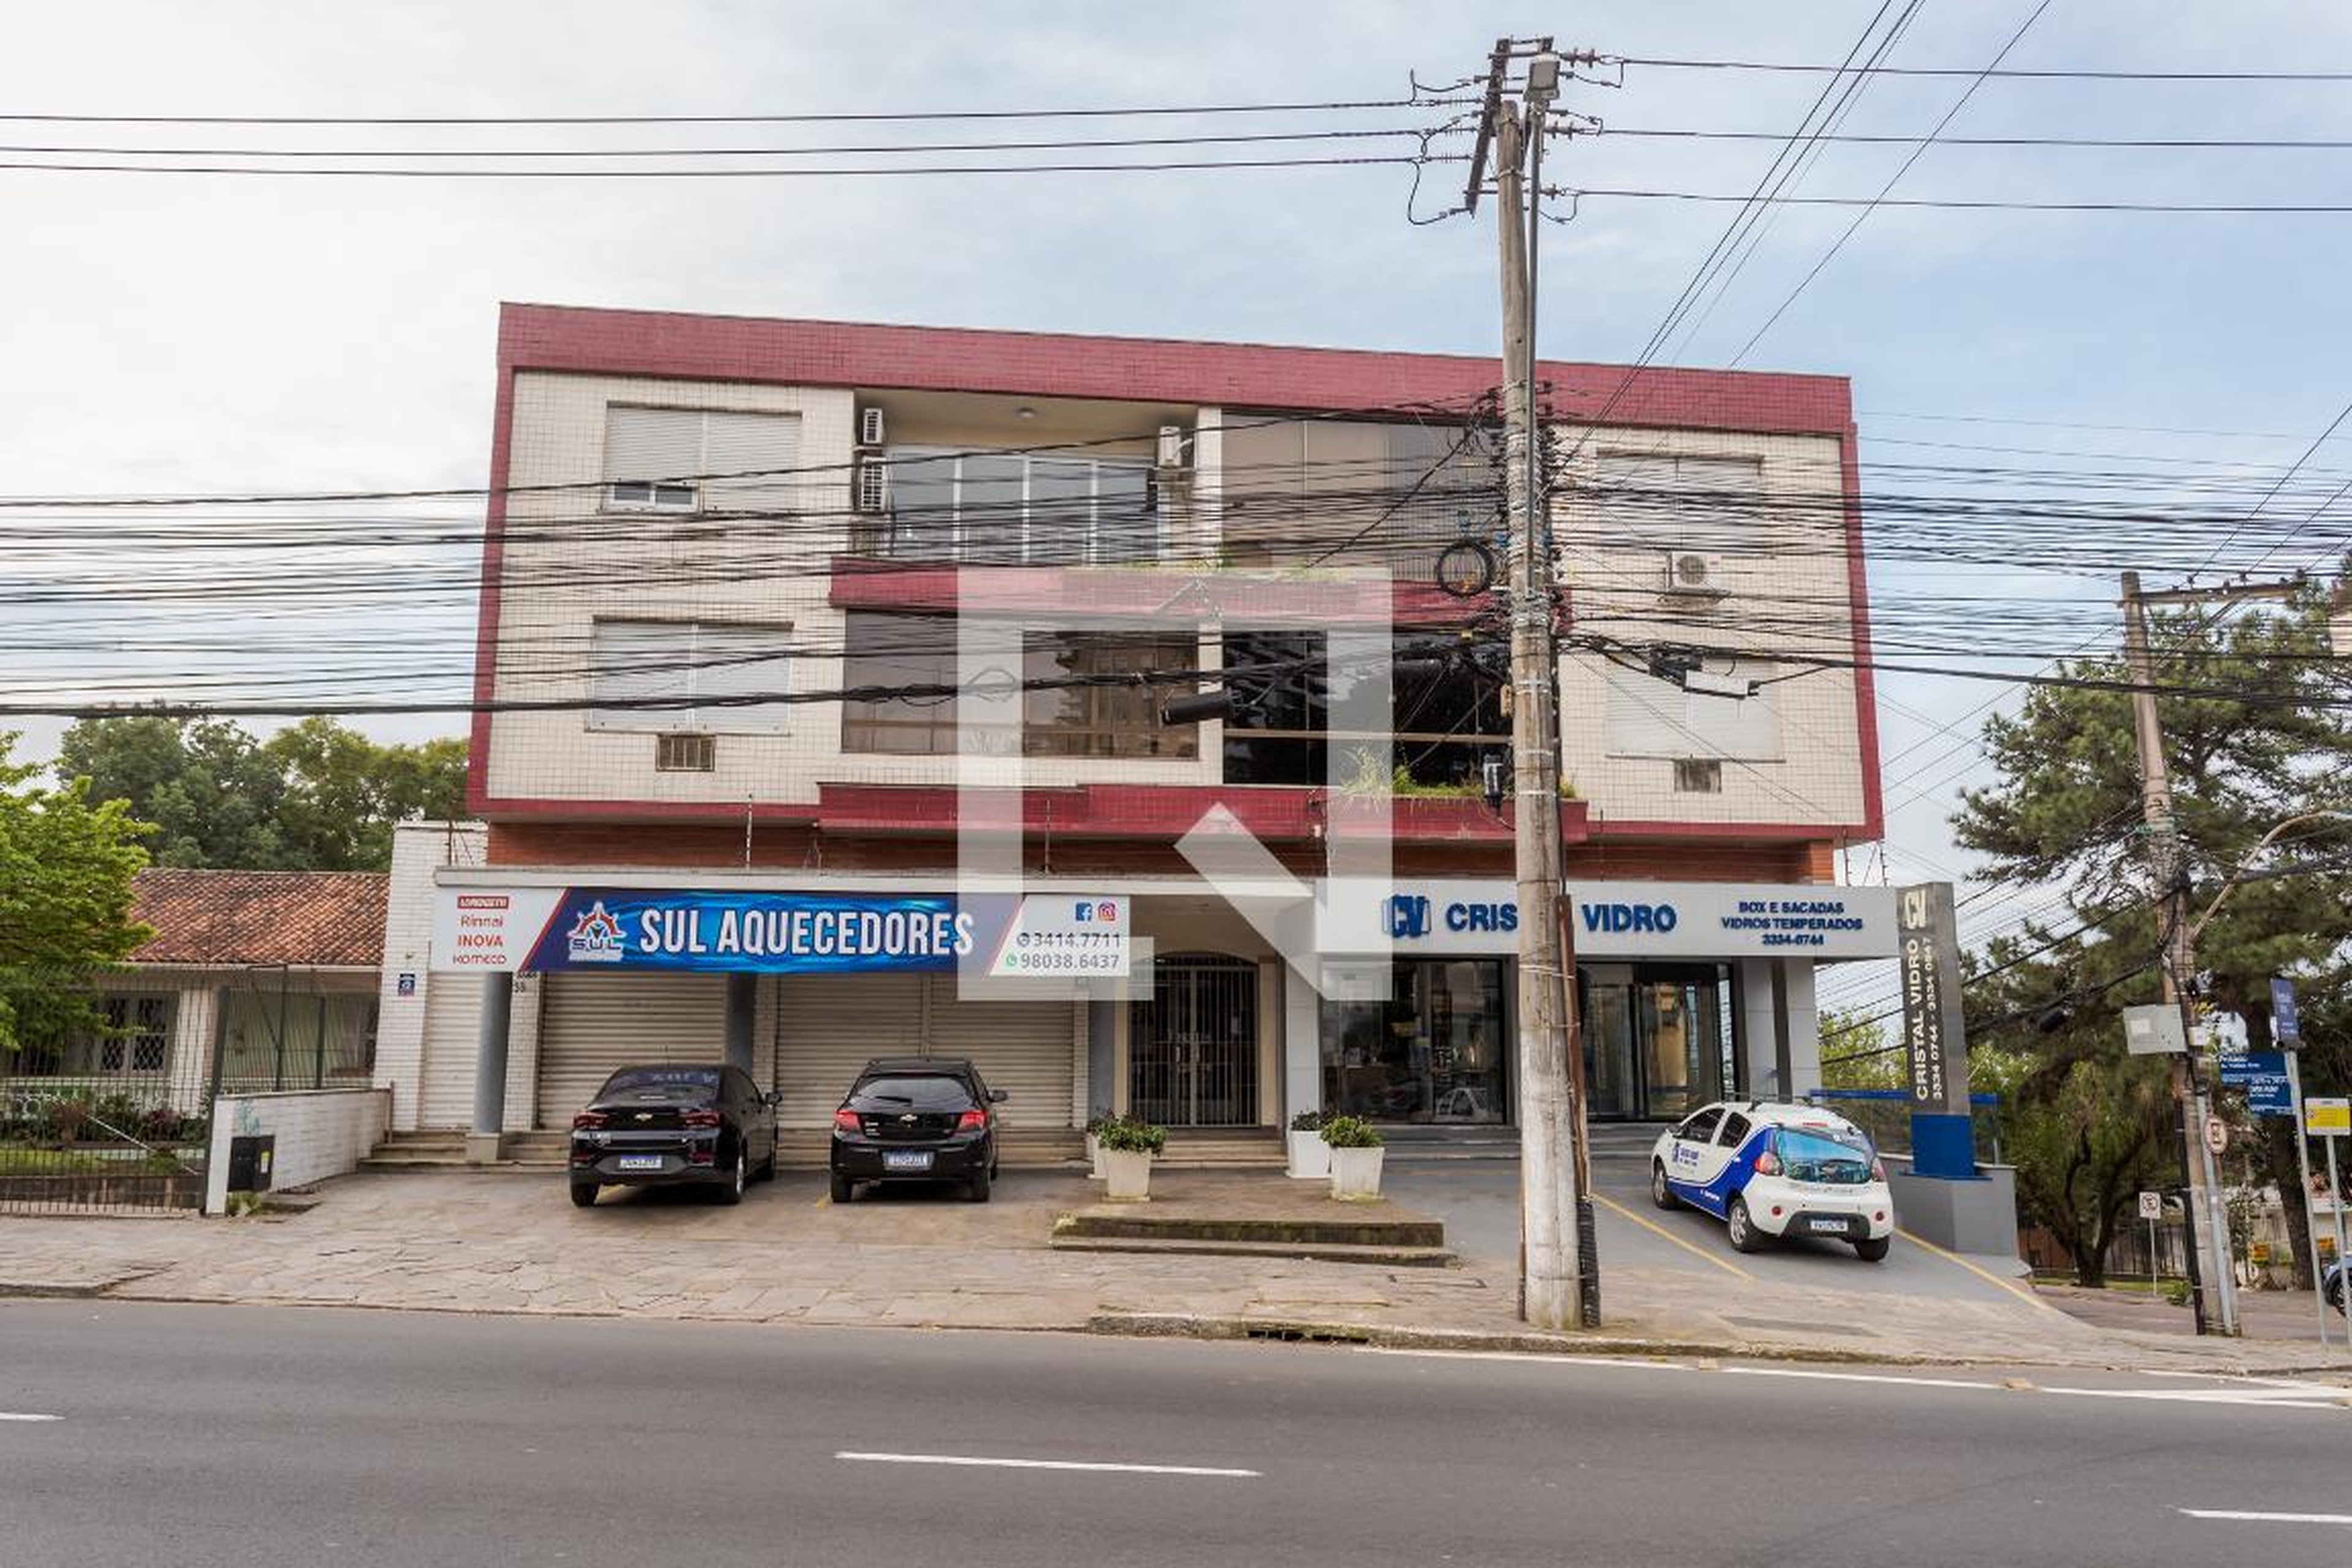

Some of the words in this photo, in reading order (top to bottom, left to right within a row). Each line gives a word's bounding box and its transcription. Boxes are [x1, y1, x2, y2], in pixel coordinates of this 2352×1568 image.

[1738, 902, 1767, 913] BOX
[1770, 902, 1777, 913] E
[1782, 902, 1844, 913] SACADAS
[1446, 903, 1518, 932] CRIS
[1581, 903, 1678, 933] VIDRO
[1722, 918, 1771, 929] VIDROS
[1775, 918, 1863, 930] TEMPERADOS
[639, 909, 707, 954] SUL
[716, 910, 974, 956] AQUECEDORES
[1033, 932, 1120, 948] 3414.7711
[457, 935, 503, 947] INOVA
[572, 938, 621, 950] SUL
[1020, 953, 1120, 969] 98038.6437
[1906, 938, 1922, 1005] VIDRO
[1912, 1011, 1929, 1101] CRISTAL
